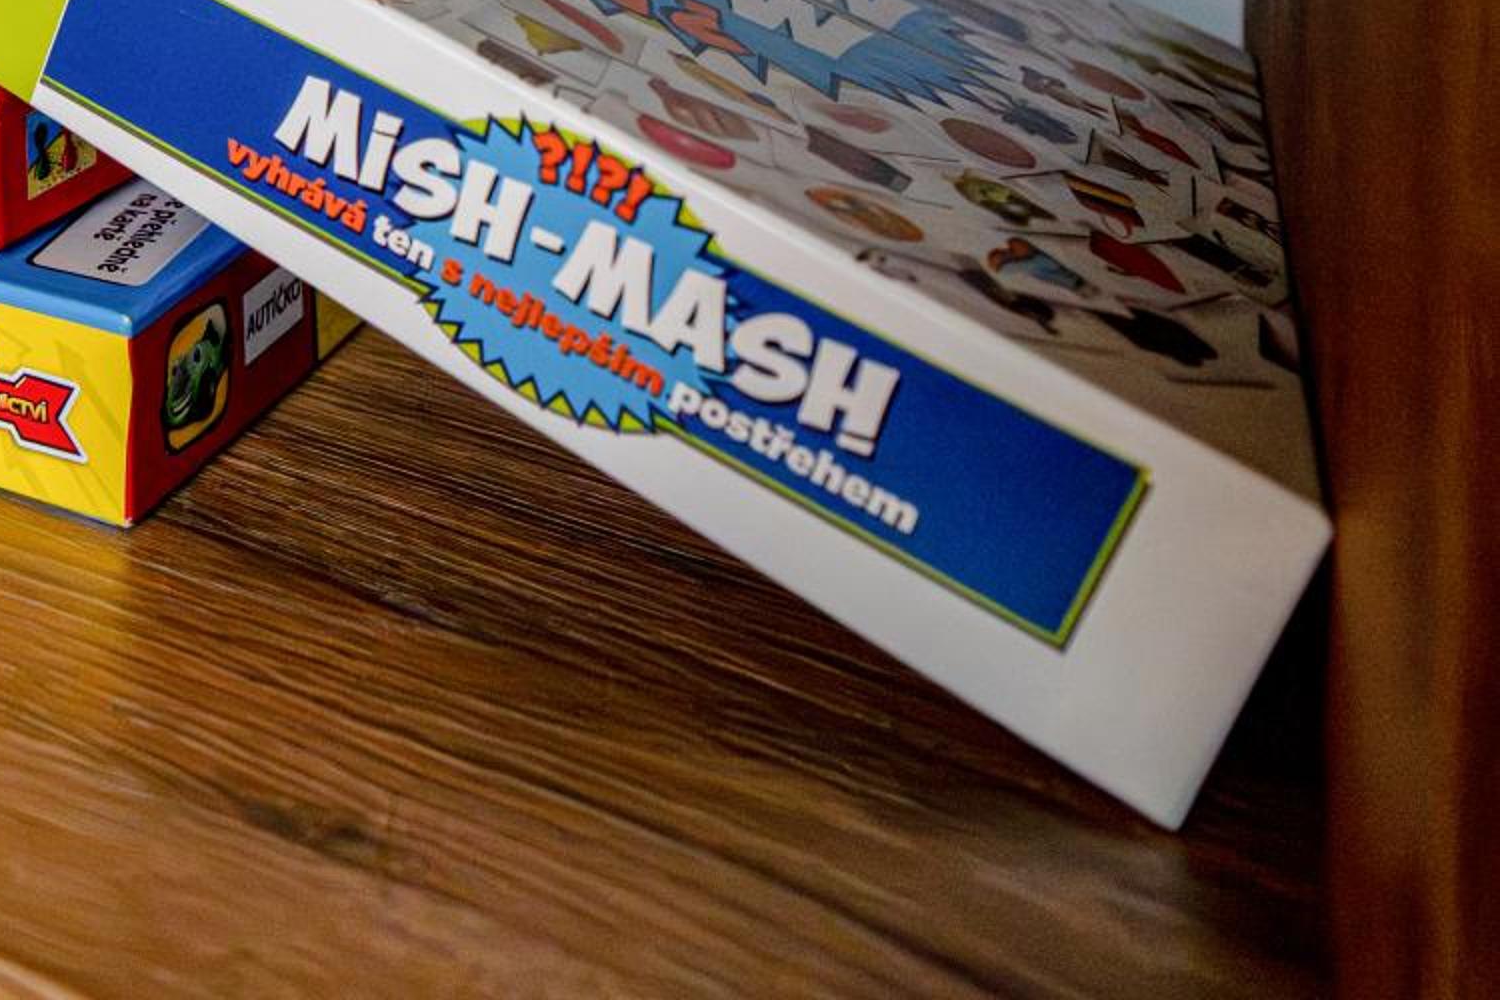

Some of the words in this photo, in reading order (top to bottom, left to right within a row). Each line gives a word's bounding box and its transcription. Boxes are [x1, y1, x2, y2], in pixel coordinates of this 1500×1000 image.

[227, 135, 368, 234] vyhrává
[371, 212, 434, 272] ten
[439, 255, 462, 286] s
[467, 266, 665, 397] nejlepším
[665, 379, 920, 536] postřehem
